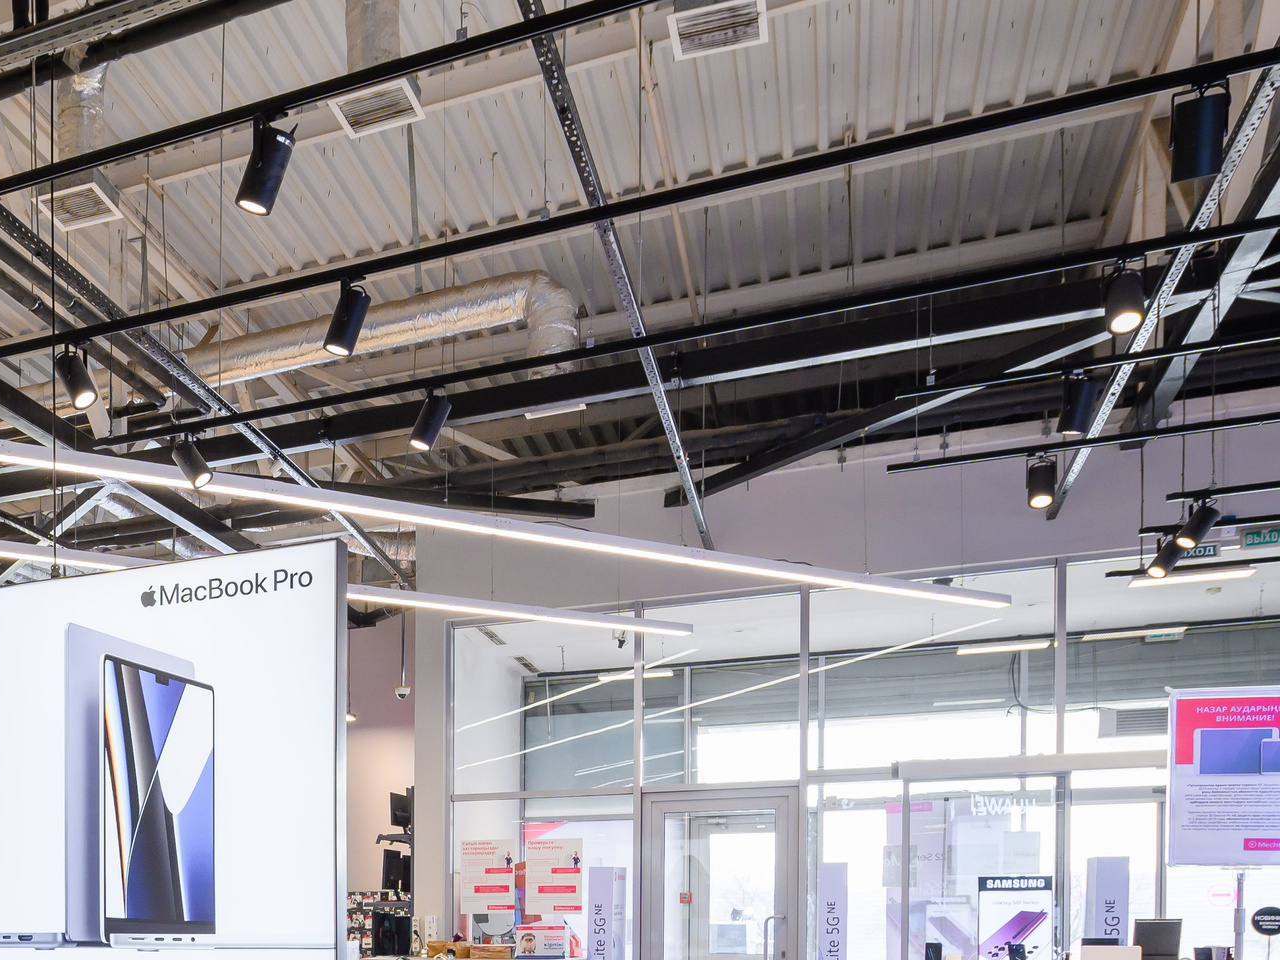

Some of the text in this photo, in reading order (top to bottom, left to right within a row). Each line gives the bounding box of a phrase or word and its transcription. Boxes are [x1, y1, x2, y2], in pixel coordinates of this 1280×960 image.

[1246, 531, 1280, 544] ВЫХО
[1182, 546, 1214, 557] ХОД
[159, 569, 313, 606] MacBook Pro
[1196, 705, 1280, 714] НАЗАР АУДАРЫҢ
[1216, 714, 1275, 722] ВНИМАНИЕ!
[986, 879, 1045, 889] SAMSUNG
